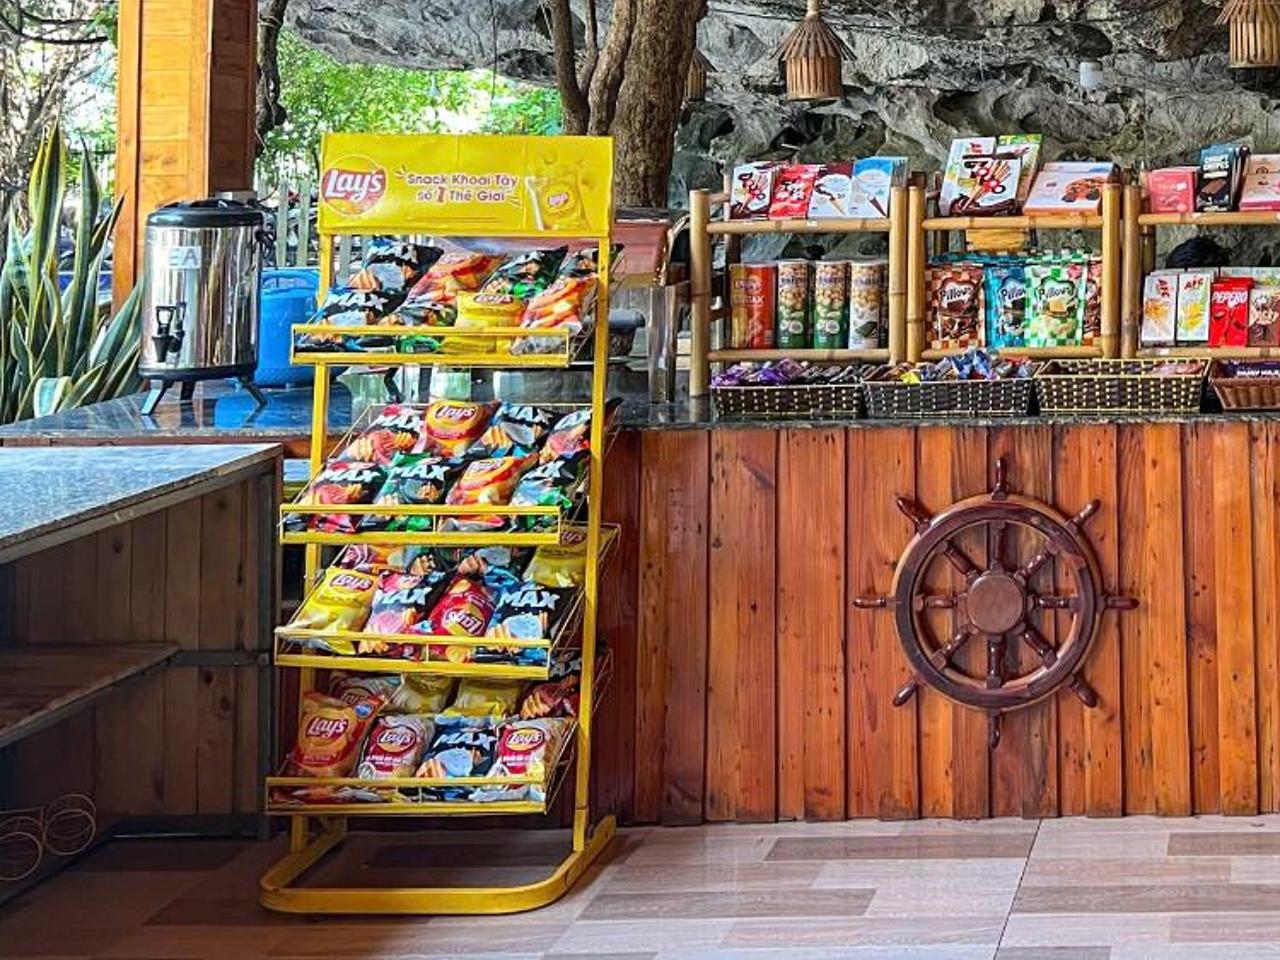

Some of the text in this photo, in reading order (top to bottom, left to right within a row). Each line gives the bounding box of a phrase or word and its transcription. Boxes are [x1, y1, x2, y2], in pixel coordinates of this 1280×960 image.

[324, 169, 386, 203] Lay's
[407, 173, 448, 186] Snack
[452, 173, 491, 186] Khoai
[436, 186, 446, 203] 1
[500, 590, 560, 610] MAX
[309, 717, 348, 738] Lay's
[378, 729, 416, 746] Lay's
[507, 728, 544, 745] Lay's
